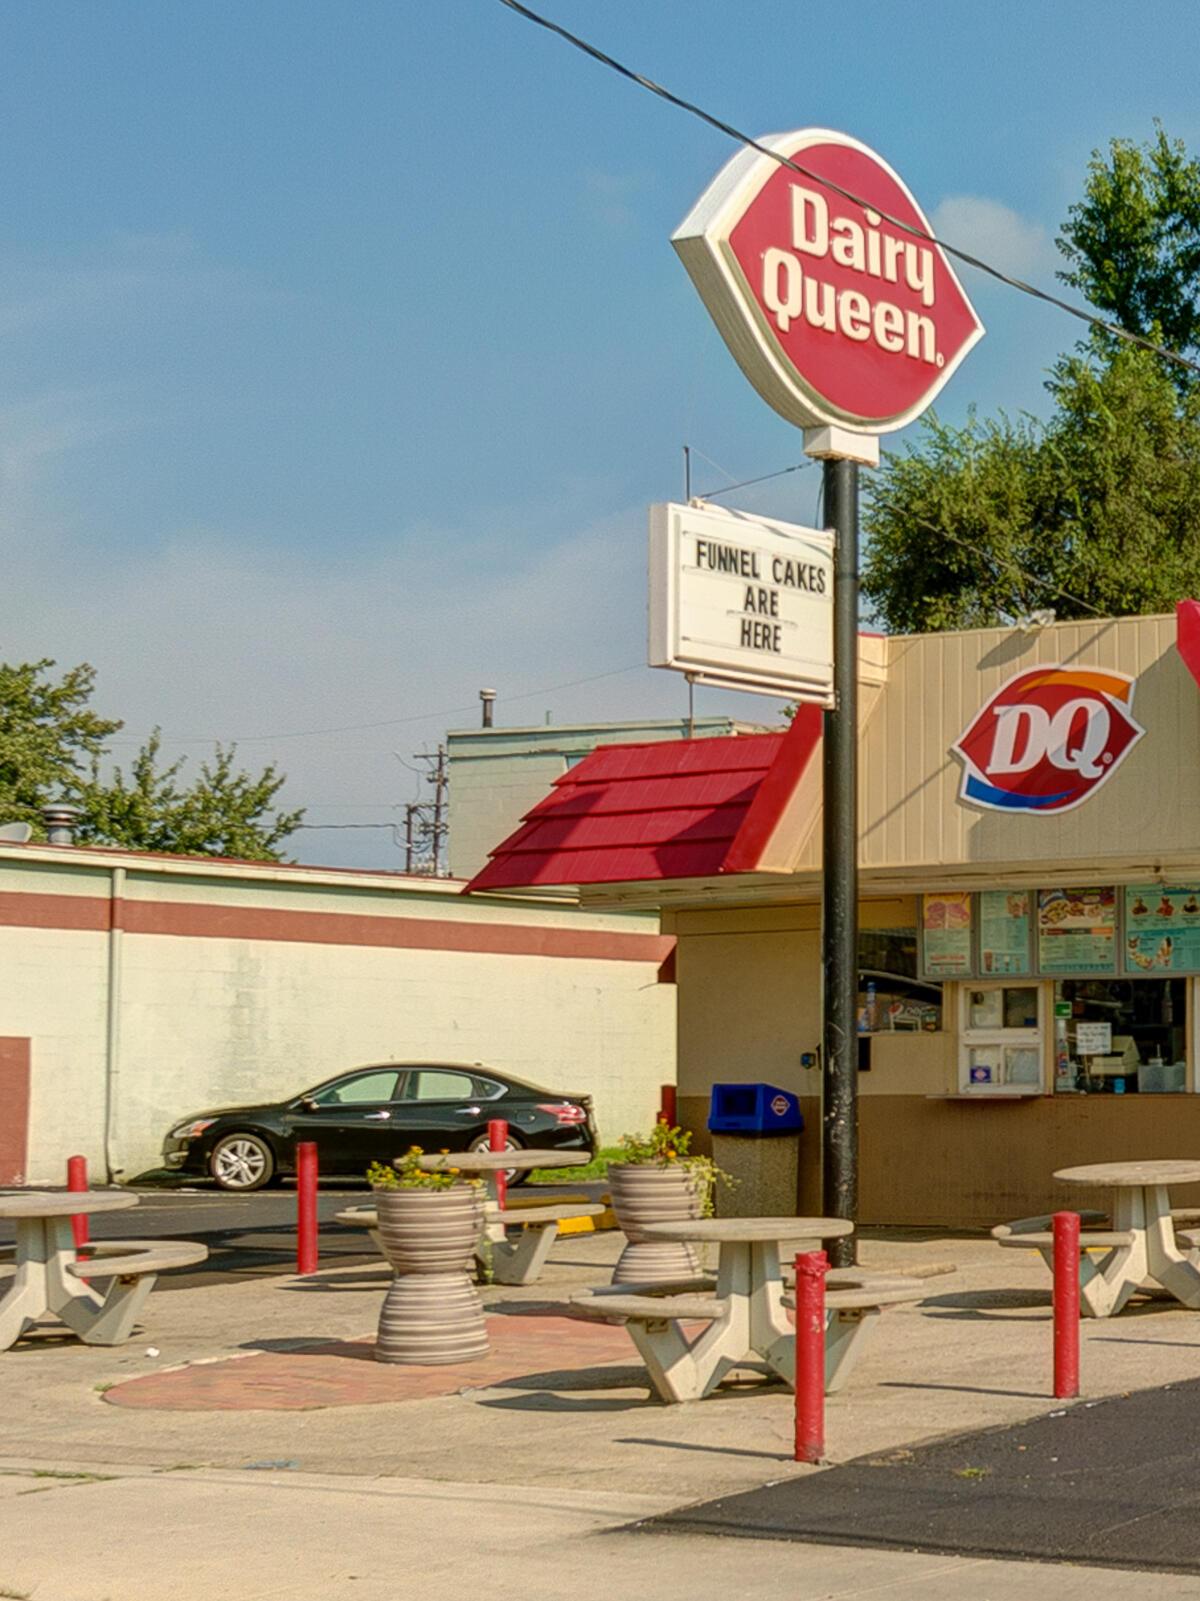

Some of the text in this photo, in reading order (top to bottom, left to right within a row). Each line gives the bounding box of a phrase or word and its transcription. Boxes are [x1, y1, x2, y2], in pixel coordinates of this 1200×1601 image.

[789, 182, 935, 308] Dairy
[761, 246, 937, 366] Queen
[696, 539, 827, 595] FUNNEL CAKES
[744, 585, 779, 617] ARE
[740, 617, 782, 653] HERE
[985, 697, 1111, 779] DQ
